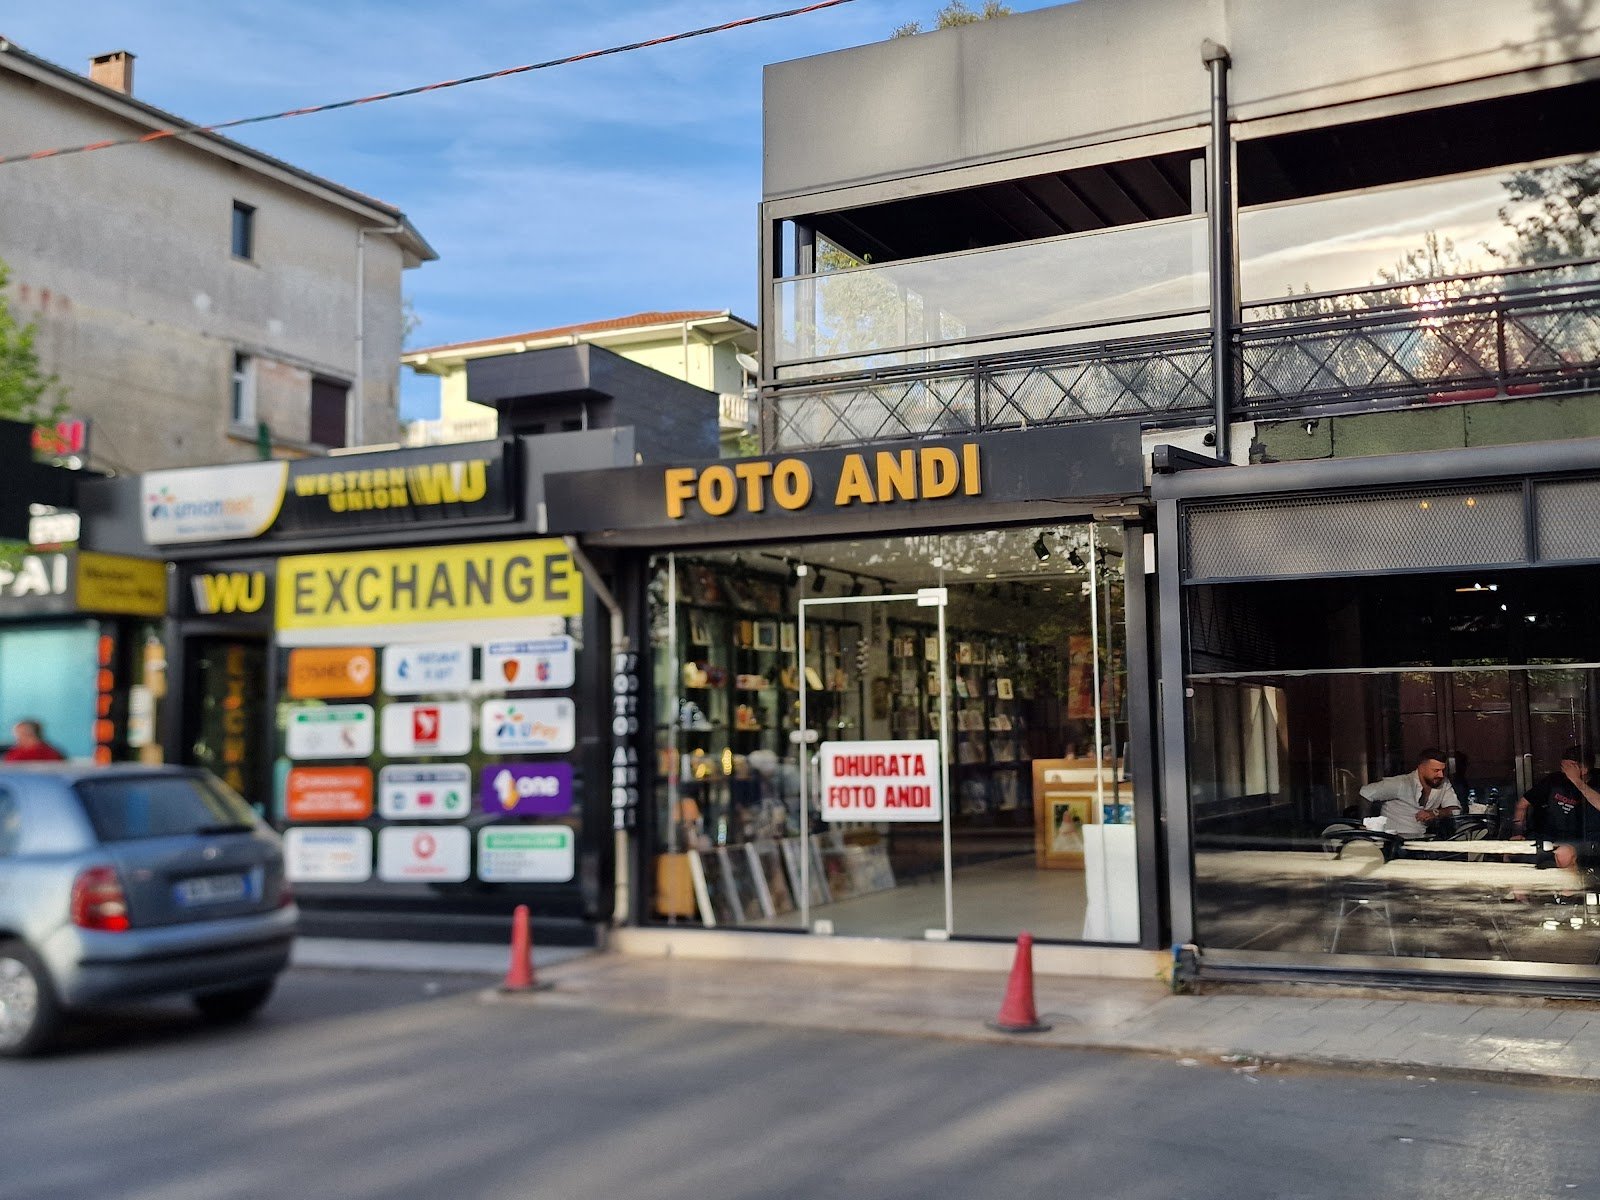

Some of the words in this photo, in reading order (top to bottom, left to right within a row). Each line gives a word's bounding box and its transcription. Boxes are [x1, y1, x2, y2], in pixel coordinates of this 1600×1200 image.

[294, 466, 407, 497] WESTERN
[409, 459, 487, 506] WU
[664, 459, 813, 519] FOTO
[834, 443, 982, 506] ANDI
[328, 487, 409, 513] UNION
[192, 571, 266, 615] WU
[294, 552, 570, 615] EXCHANGE
[833, 754, 926, 777] DHURATA
[828, 785, 876, 809] FOTO
[884, 785, 932, 809] ANDI
